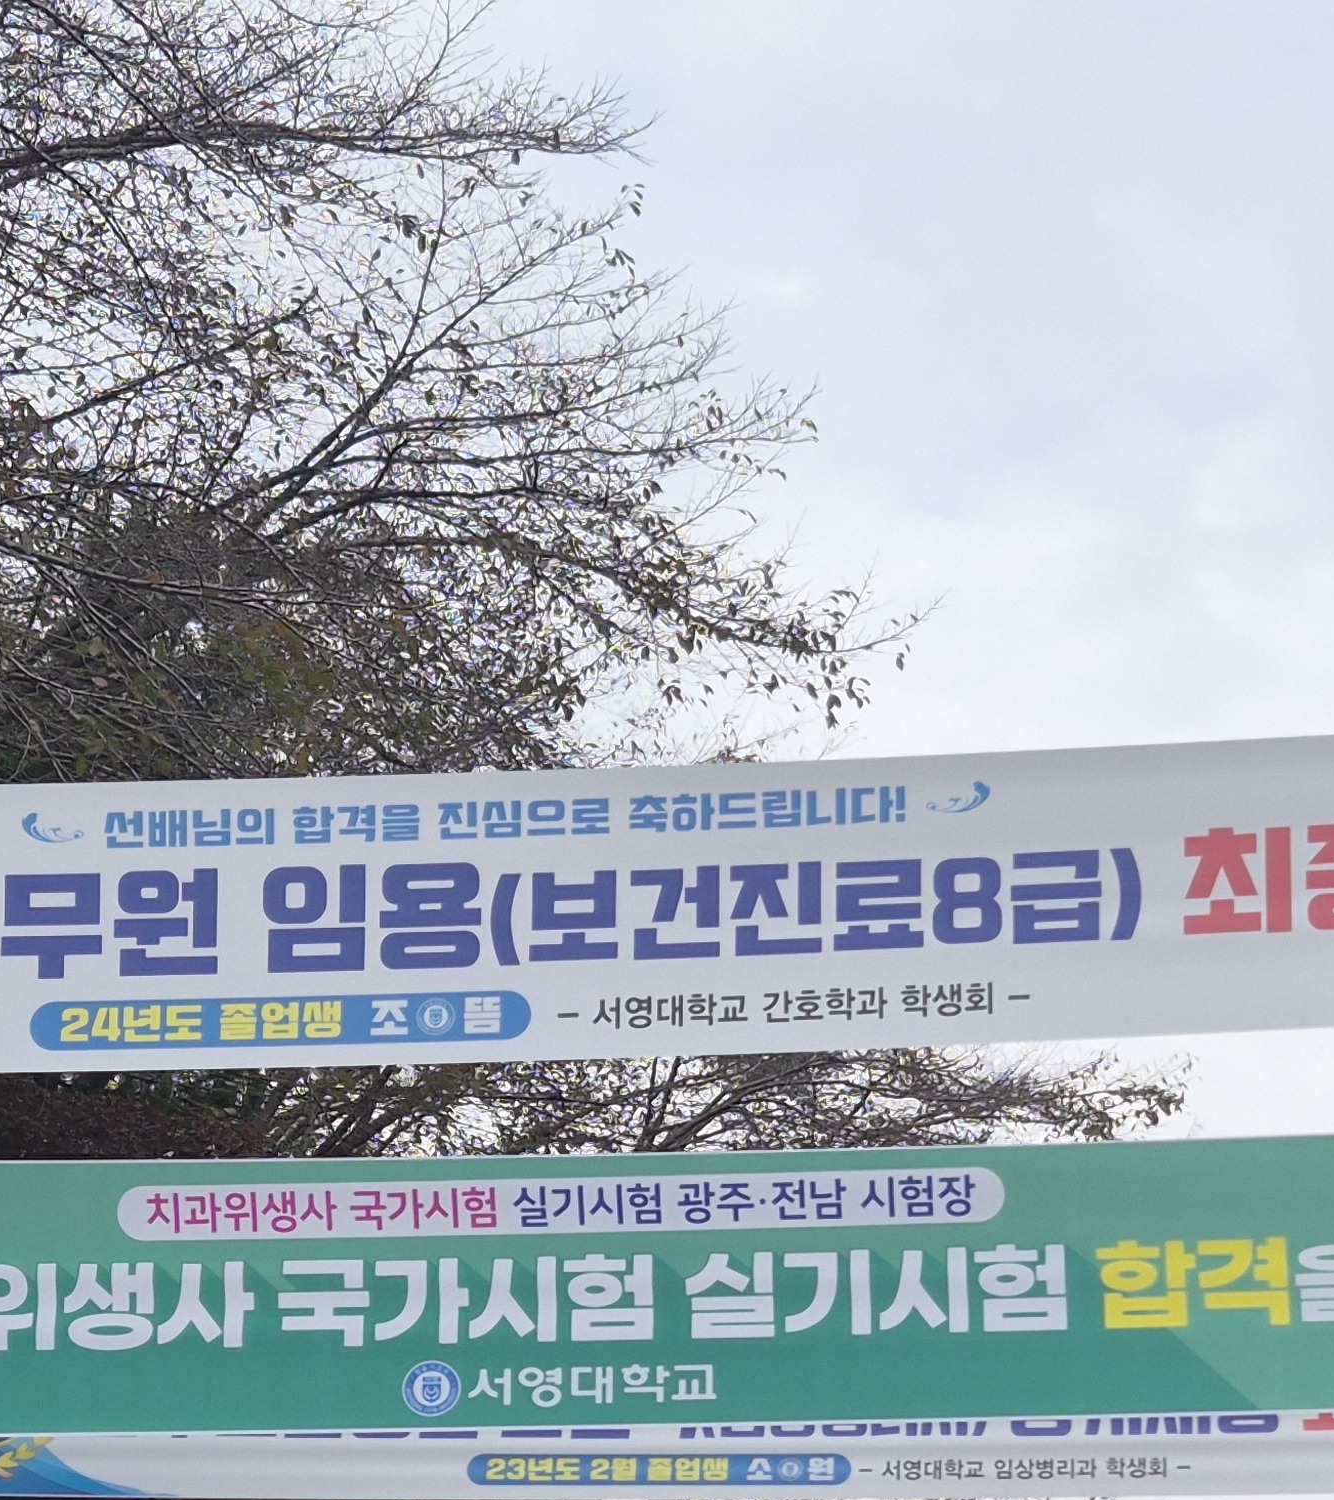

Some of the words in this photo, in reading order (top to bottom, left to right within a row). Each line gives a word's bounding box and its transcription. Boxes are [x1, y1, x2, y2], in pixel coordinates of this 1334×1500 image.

[104, 807, 274, 848] 선배님의
[293, 804, 419, 842] 합격을
[439, 797, 610, 841] 진심으로
[629, 786, 906, 832] 축하드립니다!
[263, 848, 1142, 973] 임용(보건진료8급)
[60, 1004, 202, 1042] 24년도
[220, 1001, 342, 1041] 졸업생
[593, 994, 748, 1028] 서영대학교
[762, 988, 886, 1024] 간호학과
[901, 983, 994, 1017] 학생회
[146, 1189, 336, 1234] 치과위생사
[349, 1186, 498, 1230] 국가시험
[513, 1182, 663, 1228] 실기시험
[678, 1178, 845, 1225] 광주·전남
[860, 1174, 975, 1218] 시험장
[278, 1254, 654, 1347] 국가시험
[684, 1245, 1068, 1338] 실기시험
[468, 1364, 716, 1407] 서영대학교
[486, 1457, 579, 1481] 23년도
[590, 1457, 637, 1481] 2월
[882, 1459, 984, 1480] 서영대학교
[994, 1458, 1097, 1480] 임상병리과
[1106, 1456, 1168, 1478] 학생회
